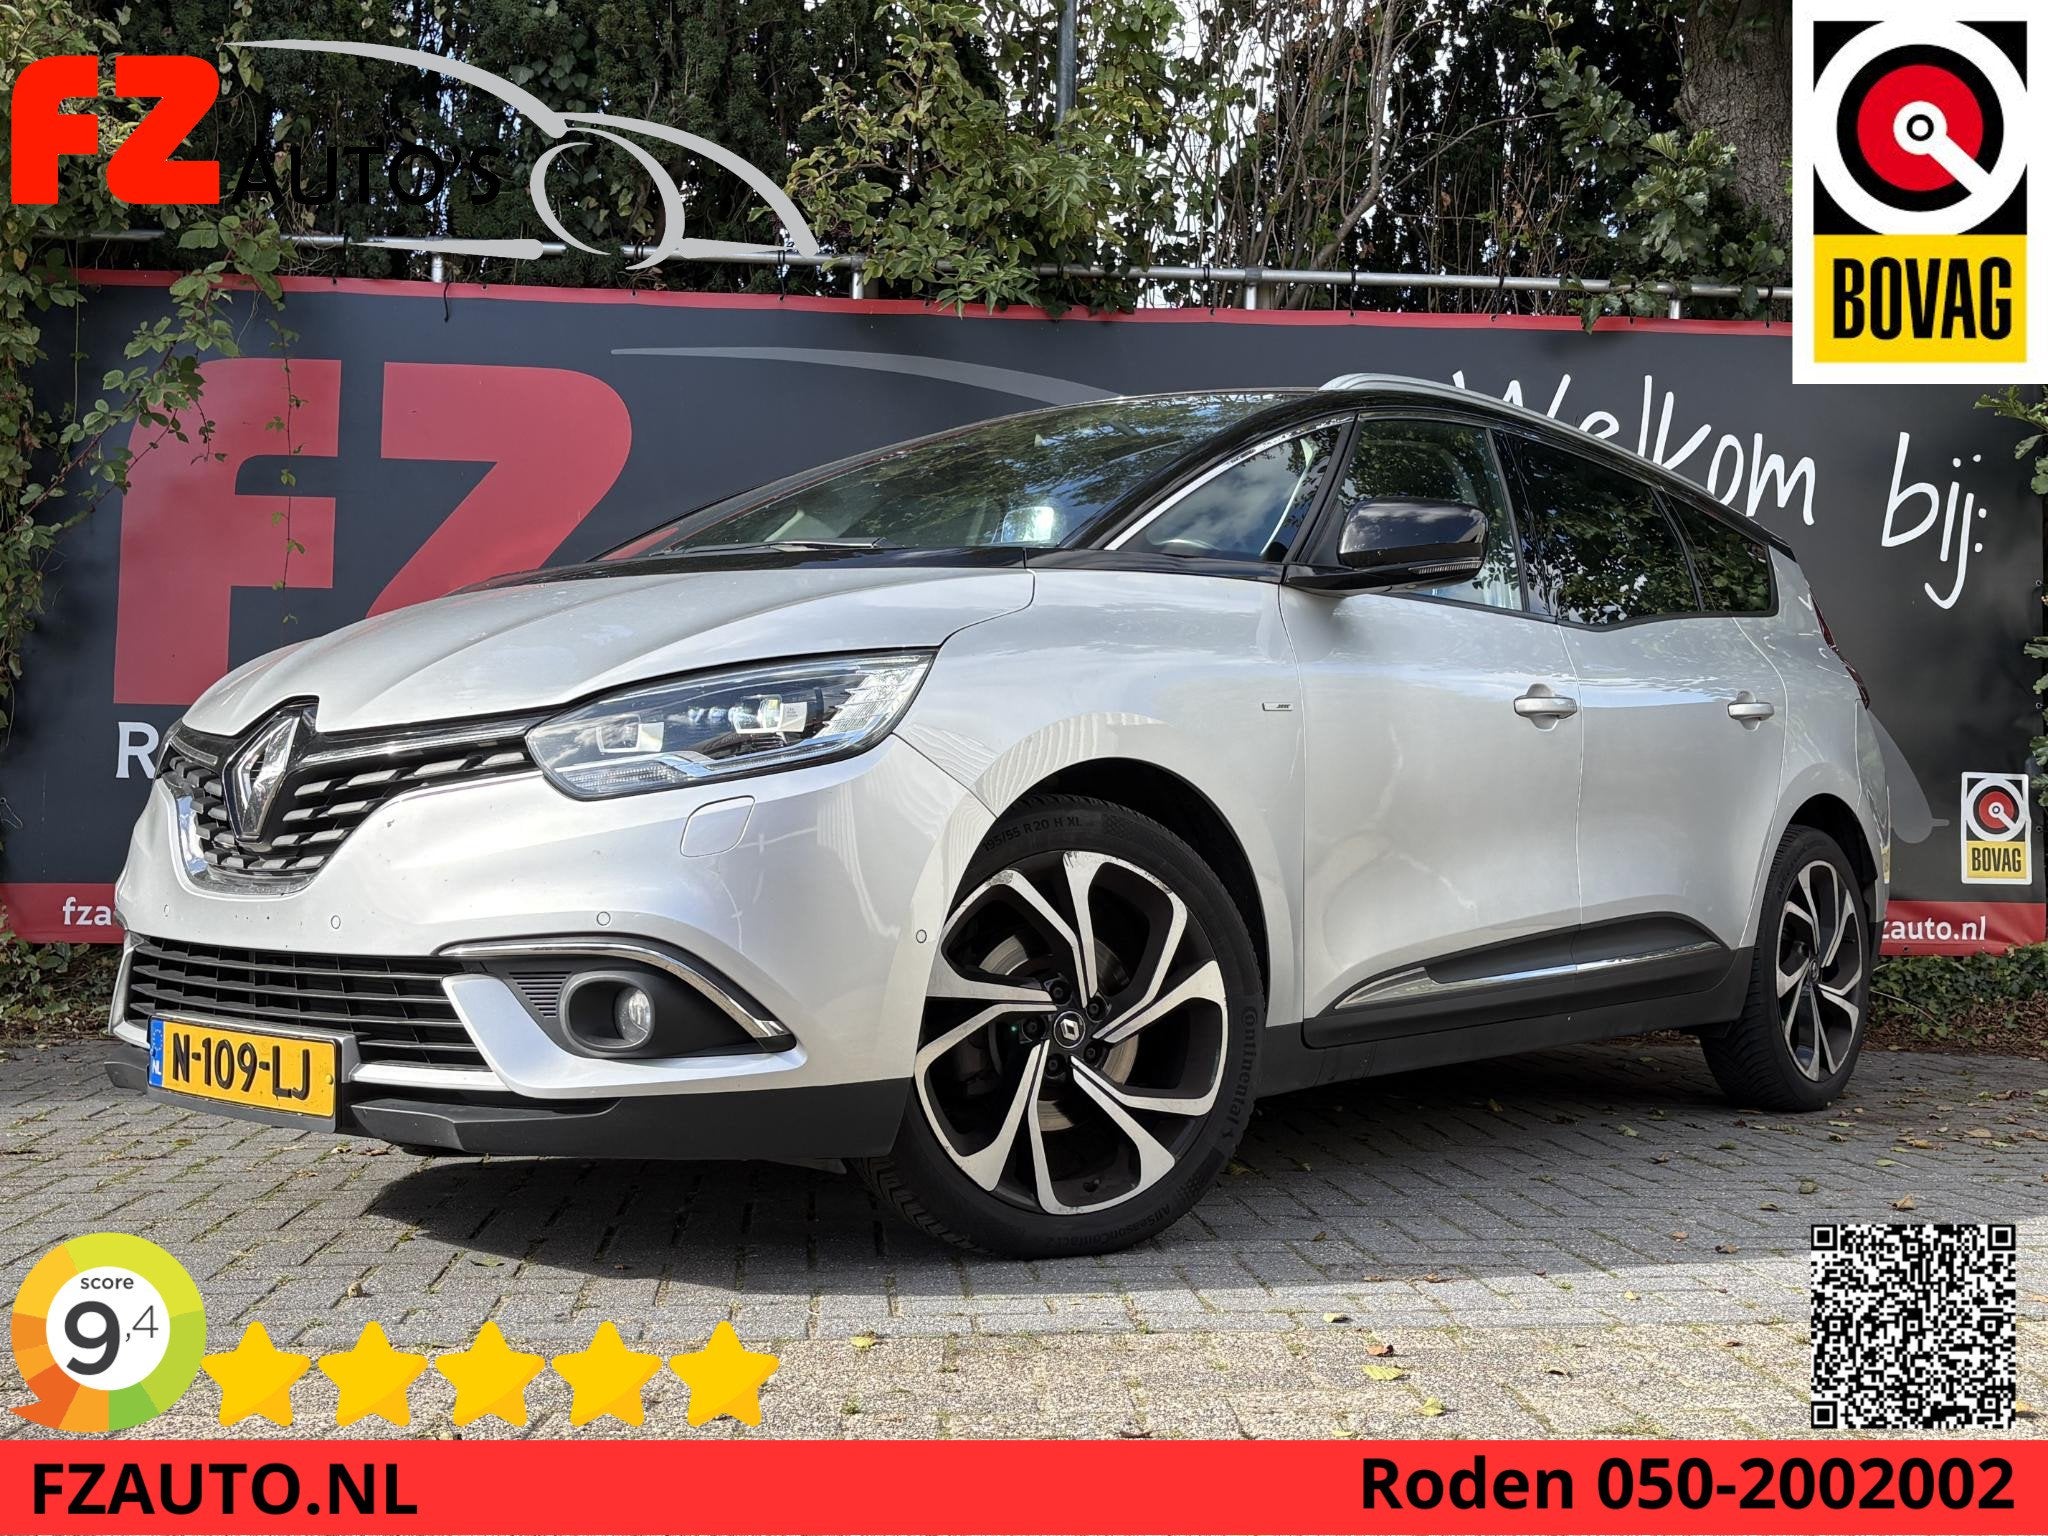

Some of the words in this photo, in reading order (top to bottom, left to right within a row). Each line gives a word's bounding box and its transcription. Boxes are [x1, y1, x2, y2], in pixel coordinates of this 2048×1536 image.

[1452, 369, 1815, 526] elkom
[1881, 431, 1987, 610] bij:
[113, 357, 632, 706] FZ
[116, 721, 159, 779] R
[982, 826, 1021, 852] 195/55
[1971, 847, 2022, 873] BOVAG
[62, 896, 112, 926] fza
[151, 1059, 162, 1076] NL
[172, 1032, 311, 1101] N-109-LJ
[1227, 1005, 1259, 1124] Continental
